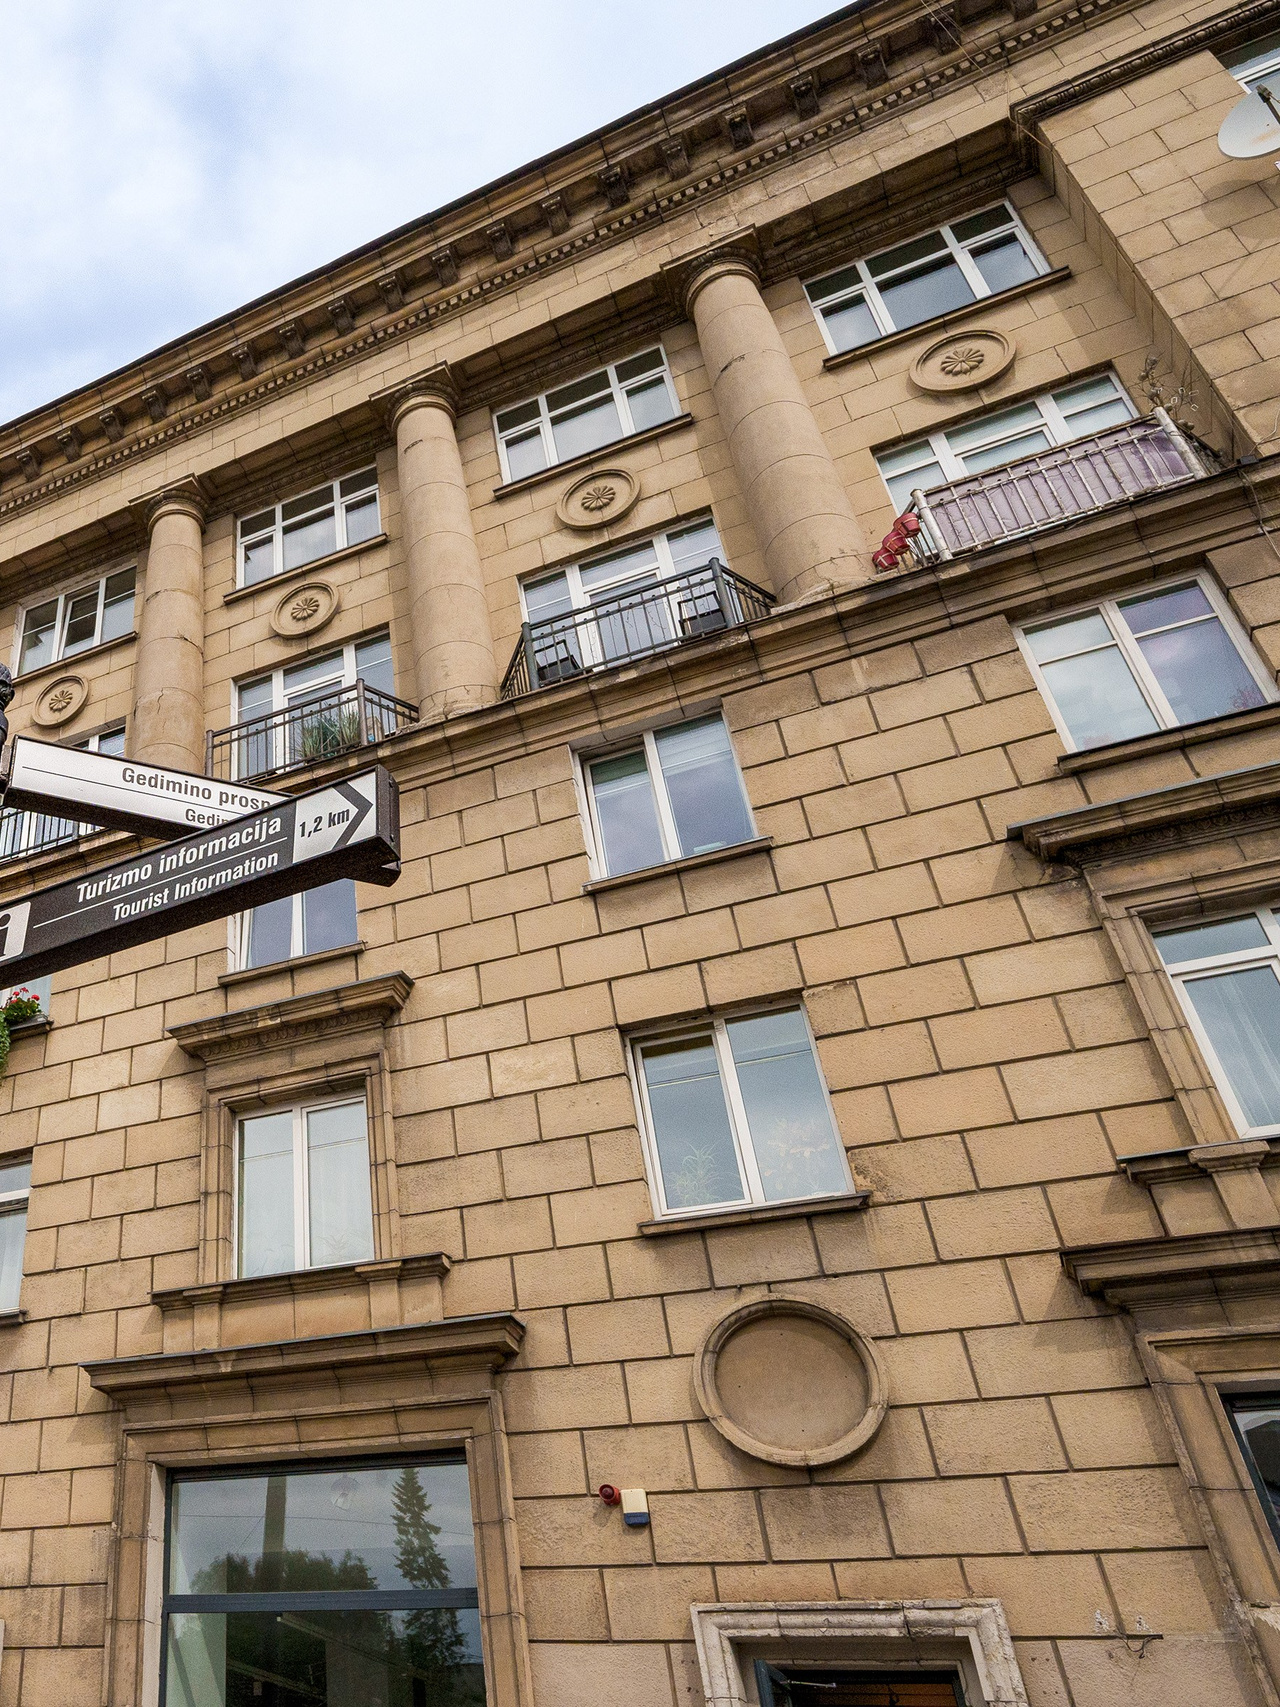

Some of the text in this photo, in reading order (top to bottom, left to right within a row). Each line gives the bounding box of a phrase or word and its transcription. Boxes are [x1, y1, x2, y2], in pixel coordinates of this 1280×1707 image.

[121, 767, 212, 801] Gedimino
[185, 808, 230, 826] Gedi
[299, 807, 350, 839] 1,2 km
[76, 814, 282, 903] Turizmo informacija
[113, 852, 279, 922] Tourist Information
